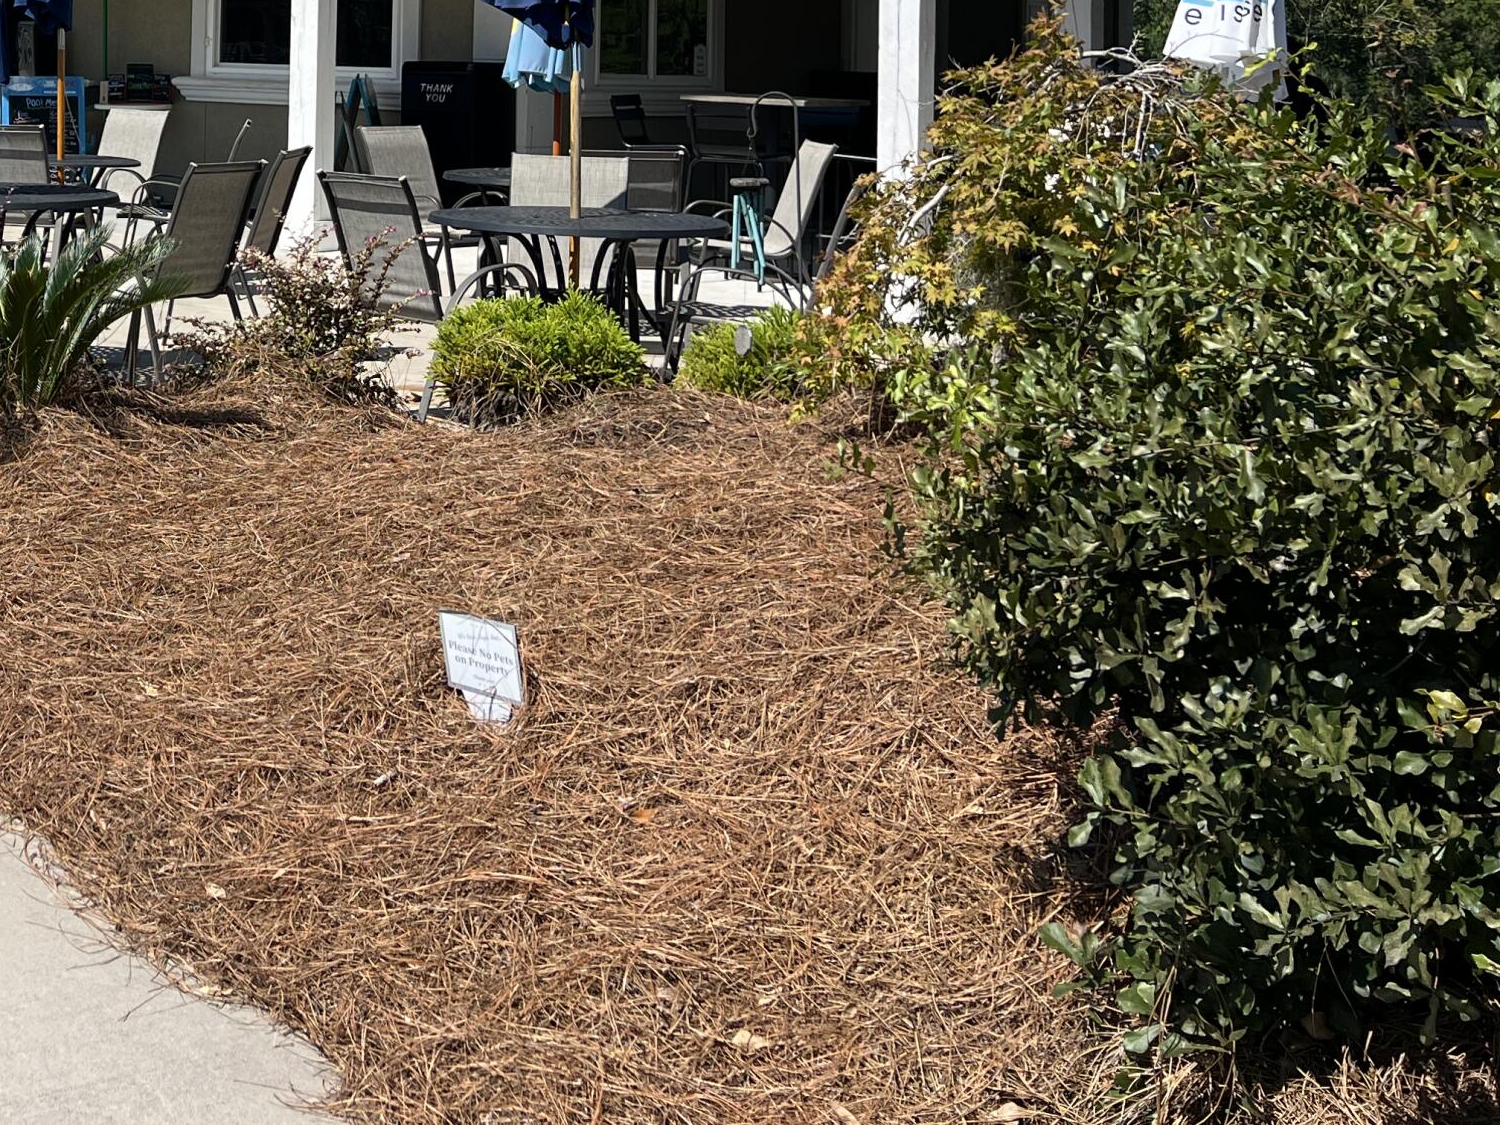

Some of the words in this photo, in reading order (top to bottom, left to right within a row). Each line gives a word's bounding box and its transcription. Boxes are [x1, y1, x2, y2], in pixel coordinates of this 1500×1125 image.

[420, 82, 454, 93] THANK
[426, 93, 446, 103] YOU
[448, 639, 477, 656] Please
[479, 649, 492, 660] No
[494, 652, 514, 666] Pets
[454, 655, 467, 664] on
[468, 657, 509, 676] Property
